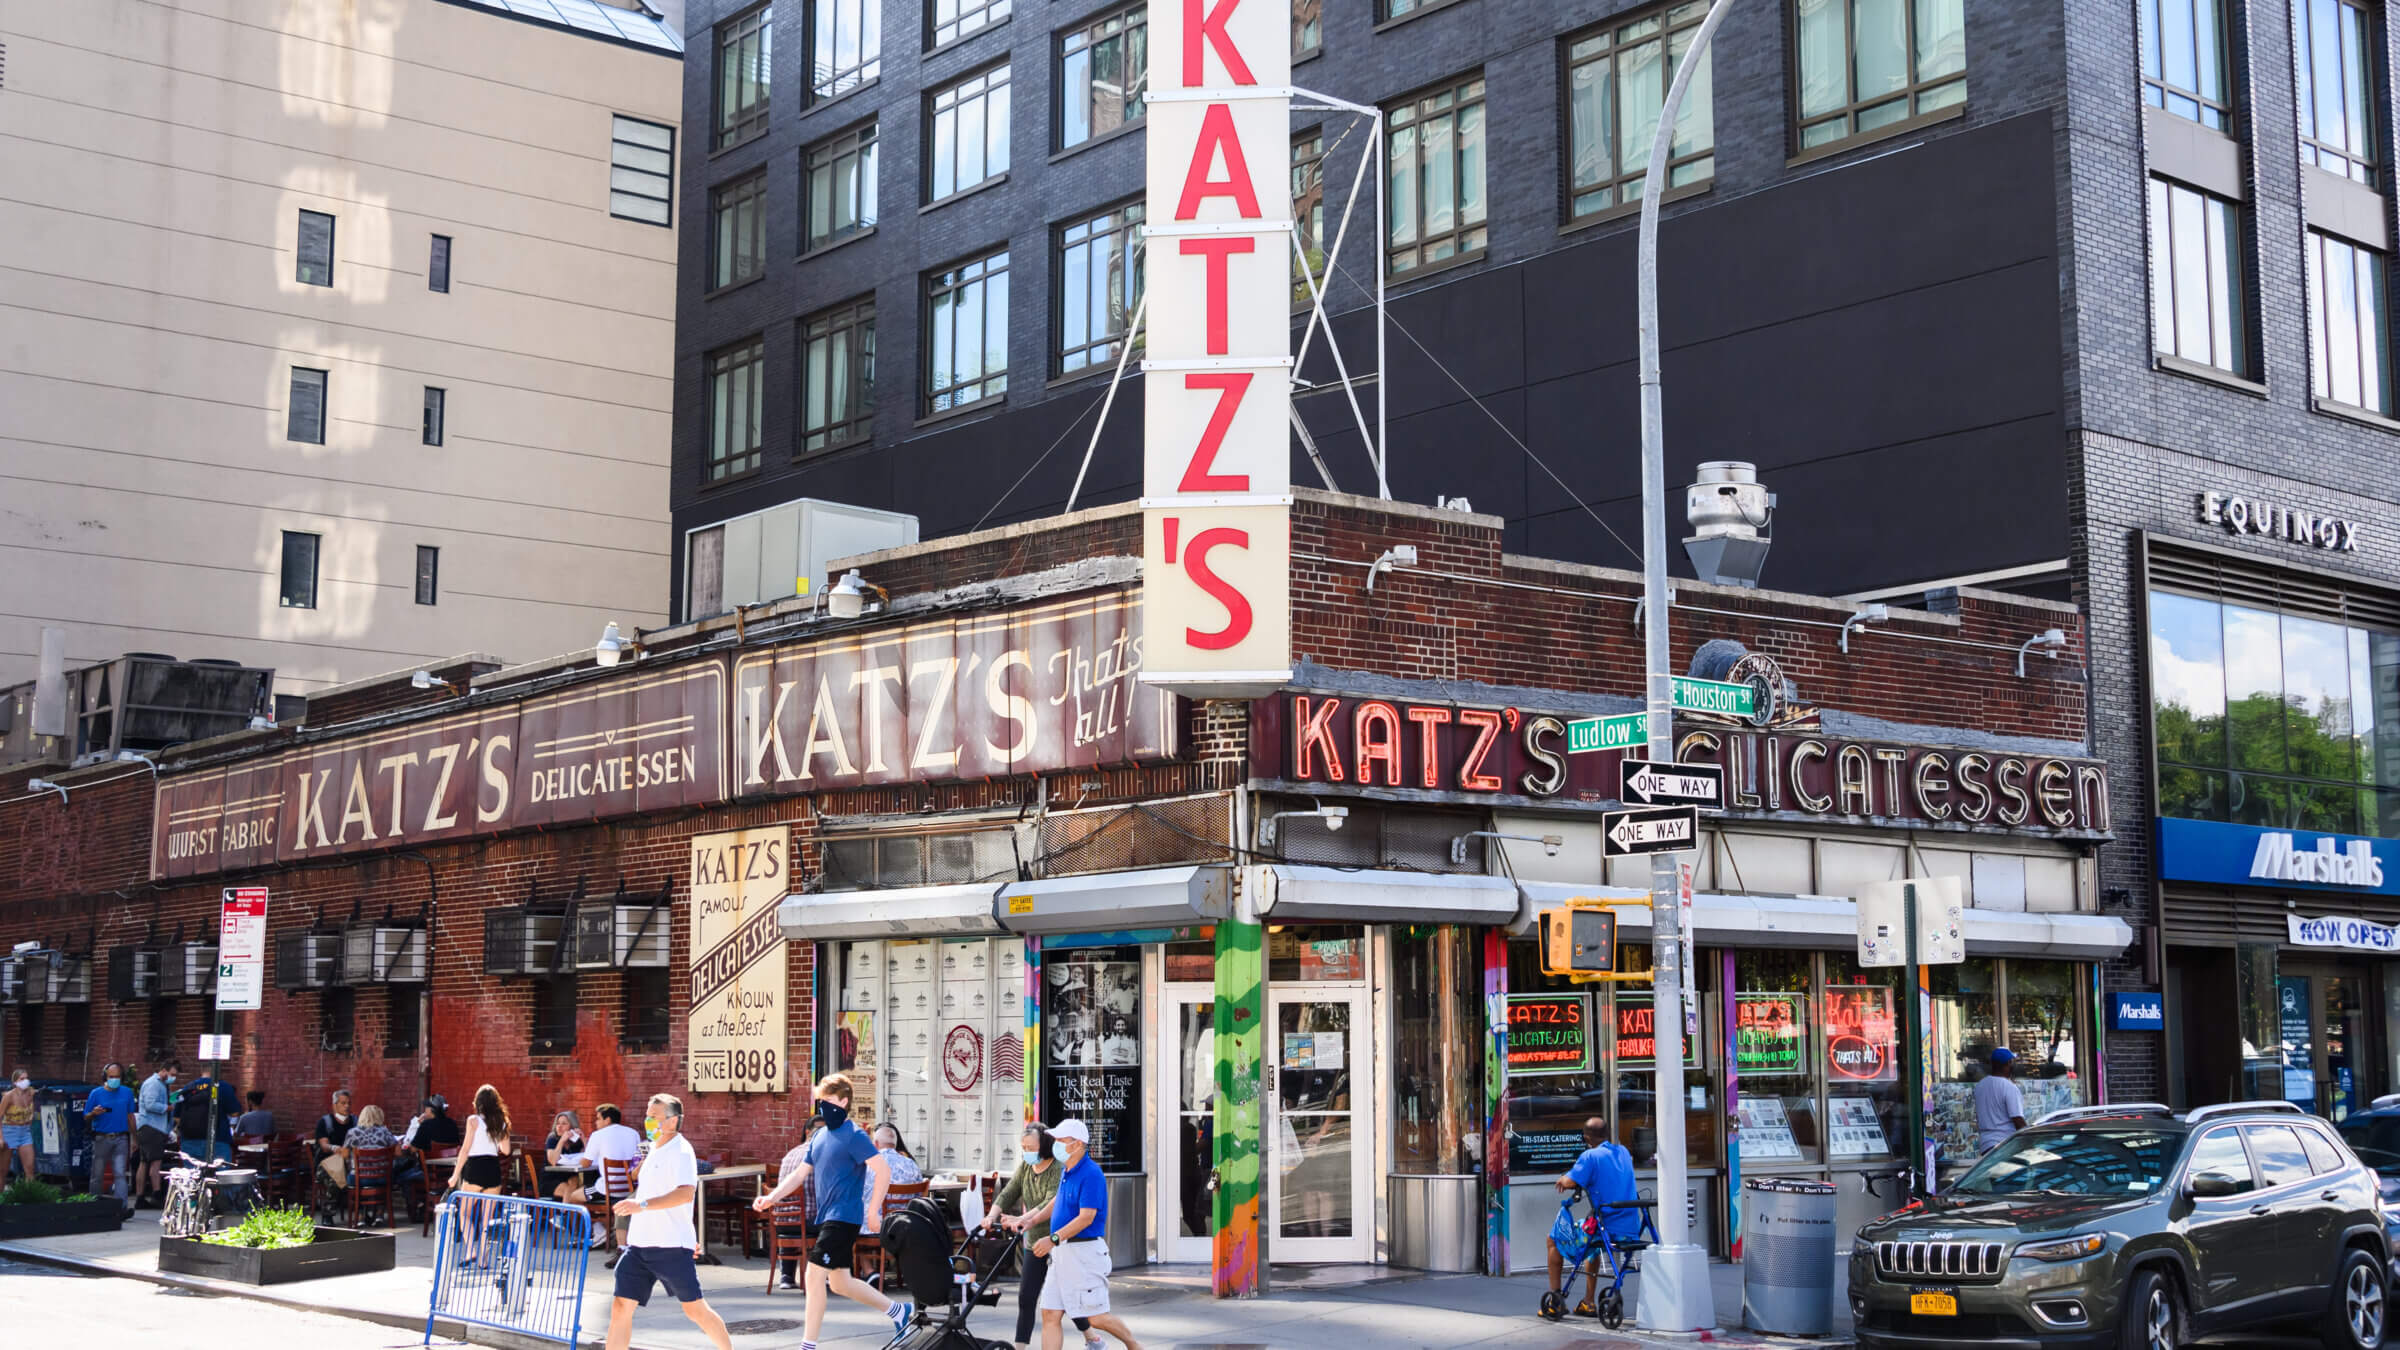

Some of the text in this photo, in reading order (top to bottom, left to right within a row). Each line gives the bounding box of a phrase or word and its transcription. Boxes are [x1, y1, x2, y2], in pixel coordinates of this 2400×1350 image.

[1163, 0, 1262, 650] KATZ'S
[2201, 490, 2359, 551] EQUINOX
[744, 627, 1143, 786] KATZ'S That's
[1671, 680, 1751, 712] E Houston St
[1570, 715, 1648, 751] Ludlow St
[530, 744, 697, 805] DELICATESSEN
[1295, 696, 2111, 832] KATZ'S LICATESSEN
[294, 734, 514, 851] KATZ'S
[1638, 774, 1710, 797] ONE WAY
[168, 816, 276, 861] WURST FABRIC
[1618, 821, 1684, 842] ONE WAY
[695, 838, 781, 886] KATZ'S
[2249, 832, 2384, 888] Marshalls
[2299, 920, 2396, 947] NOW OPEN
[727, 990, 774, 1010] KNOWN
[2119, 1003, 2161, 1020] Marshalls
[701, 1011, 767, 1038] as the Best
[1508, 1031, 1583, 1047] ELICATESSEN
[693, 1061, 726, 1080] SINCE
[1056, 1074, 1133, 1088] The Real Taste
[1059, 1087, 1072, 1099] of
[1073, 1087, 1099, 1099] New
[1063, 1098, 1127, 1111] Since 1888.
[1522, 1135, 1550, 1144] TRI-STATE
[1930, 1231, 1953, 1241] Jeep
